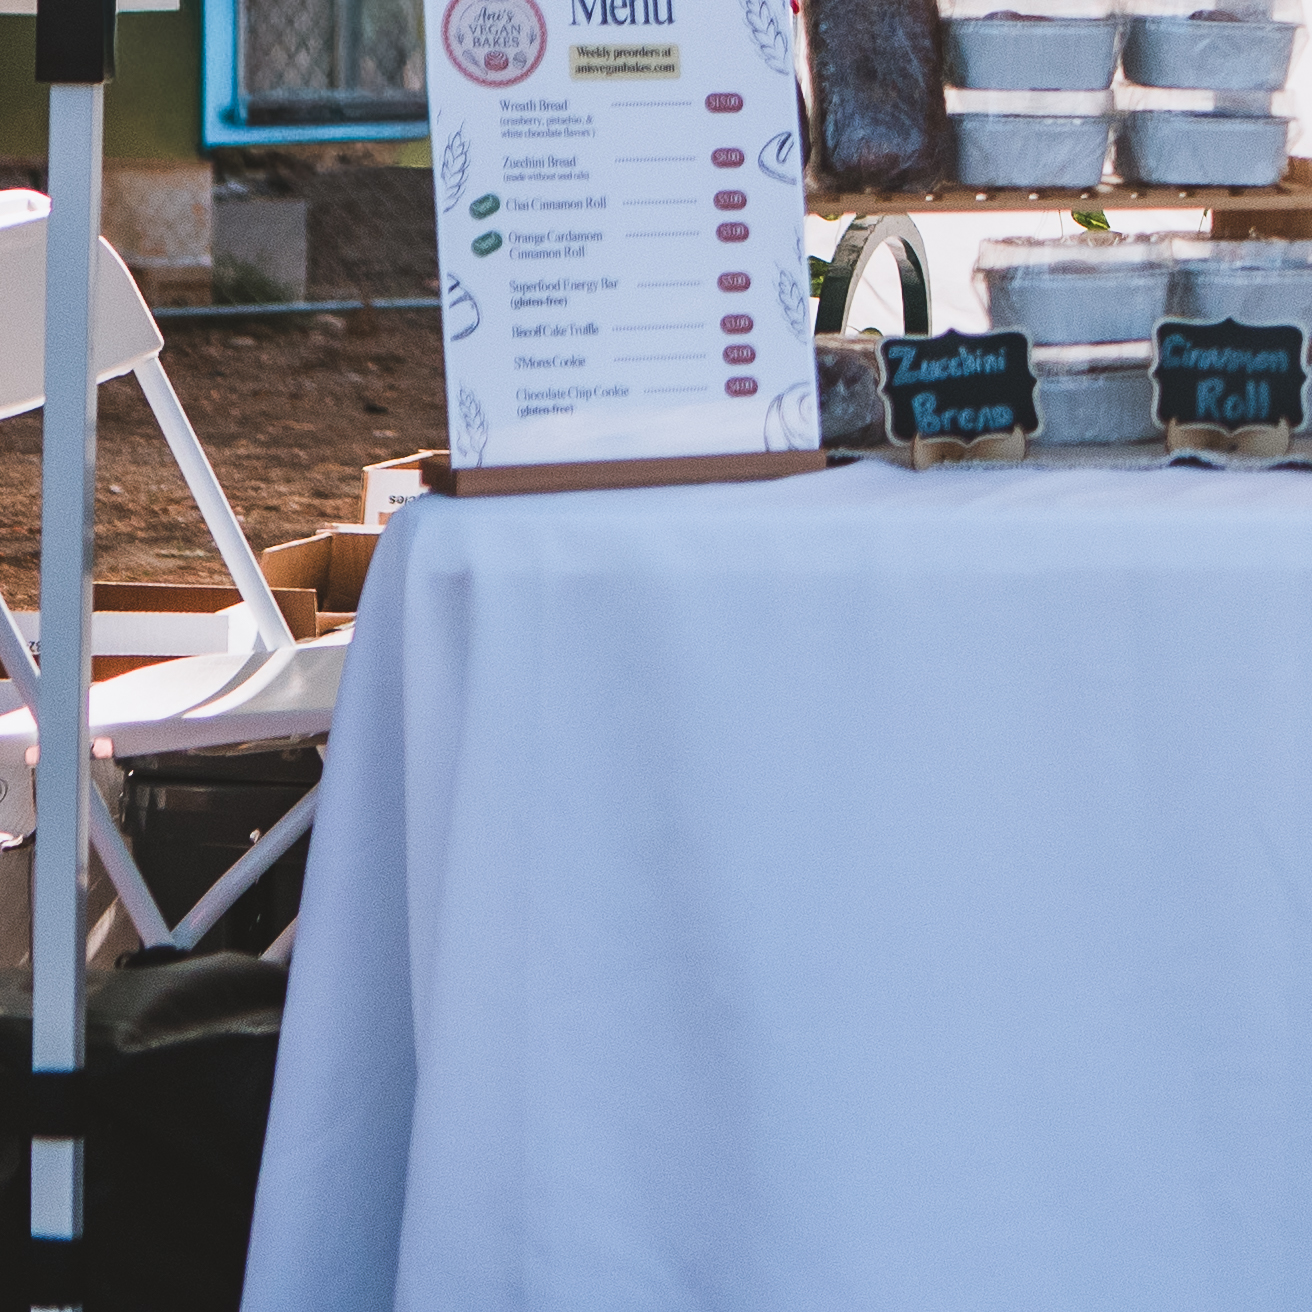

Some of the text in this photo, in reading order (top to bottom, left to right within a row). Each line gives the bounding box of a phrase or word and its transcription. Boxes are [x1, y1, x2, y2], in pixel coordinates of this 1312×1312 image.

[473, 6, 515, 24] Ani's
[468, 24, 522, 36] VEGAN
[472, 36, 520, 48] BAKES
[576, 46, 671, 61] Weekly preorders at
[575, 61, 675, 75] anisveganbakes.com
[500, 99, 536, 112] Wreath
[539, 99, 568, 112] Bread
[503, 156, 545, 169] Zucchini
[547, 155, 577, 168] Bread
[506, 197, 530, 211] Chai
[531, 197, 583, 211] Cinnamon
[586, 196, 607, 209] Roll
[508, 231, 545, 246] Orange
[546, 230, 603, 243] Cardamom
[509, 246, 585, 260] Cinnamon Roll
[509, 279, 562, 295] Superfood
[563, 279, 598, 293] Energy
[601, 277, 619, 289] Bar
[510, 296, 568, 310] (gluten-free)
[511, 325, 543, 338] Biscoff
[543, 324, 567, 337] Cake
[569, 323, 599, 336] Truffle
[552, 354, 586, 368] Cookie
[516, 387, 566, 402] Chocolate
[567, 386, 592, 401] Chip
[593, 385, 630, 398] Cookie
[516, 404, 574, 418] (gluten-free)
